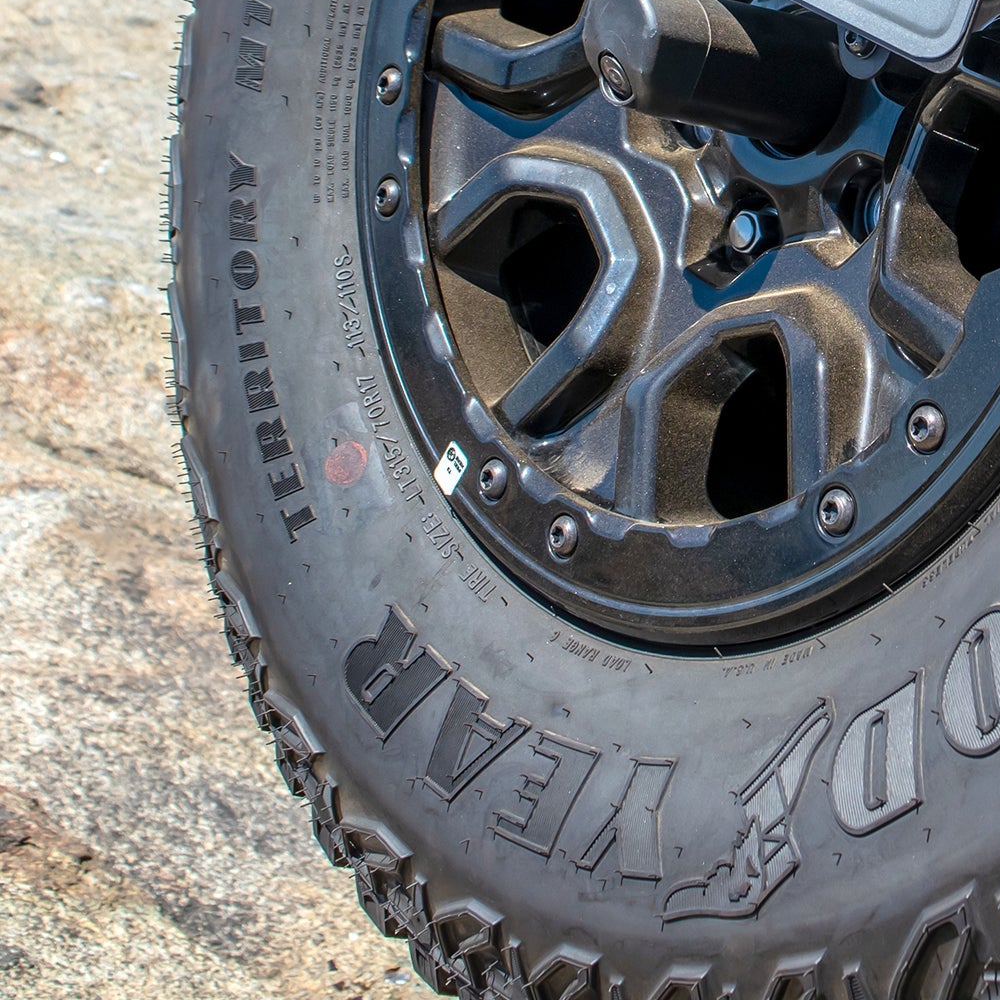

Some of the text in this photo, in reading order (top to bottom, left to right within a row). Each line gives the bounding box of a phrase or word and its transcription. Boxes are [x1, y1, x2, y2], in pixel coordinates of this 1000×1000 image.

[228, 151, 317, 543] TERRITORY
[333, 254, 497, 603] TIRE SIZE: LT315/70R17 113/110S
